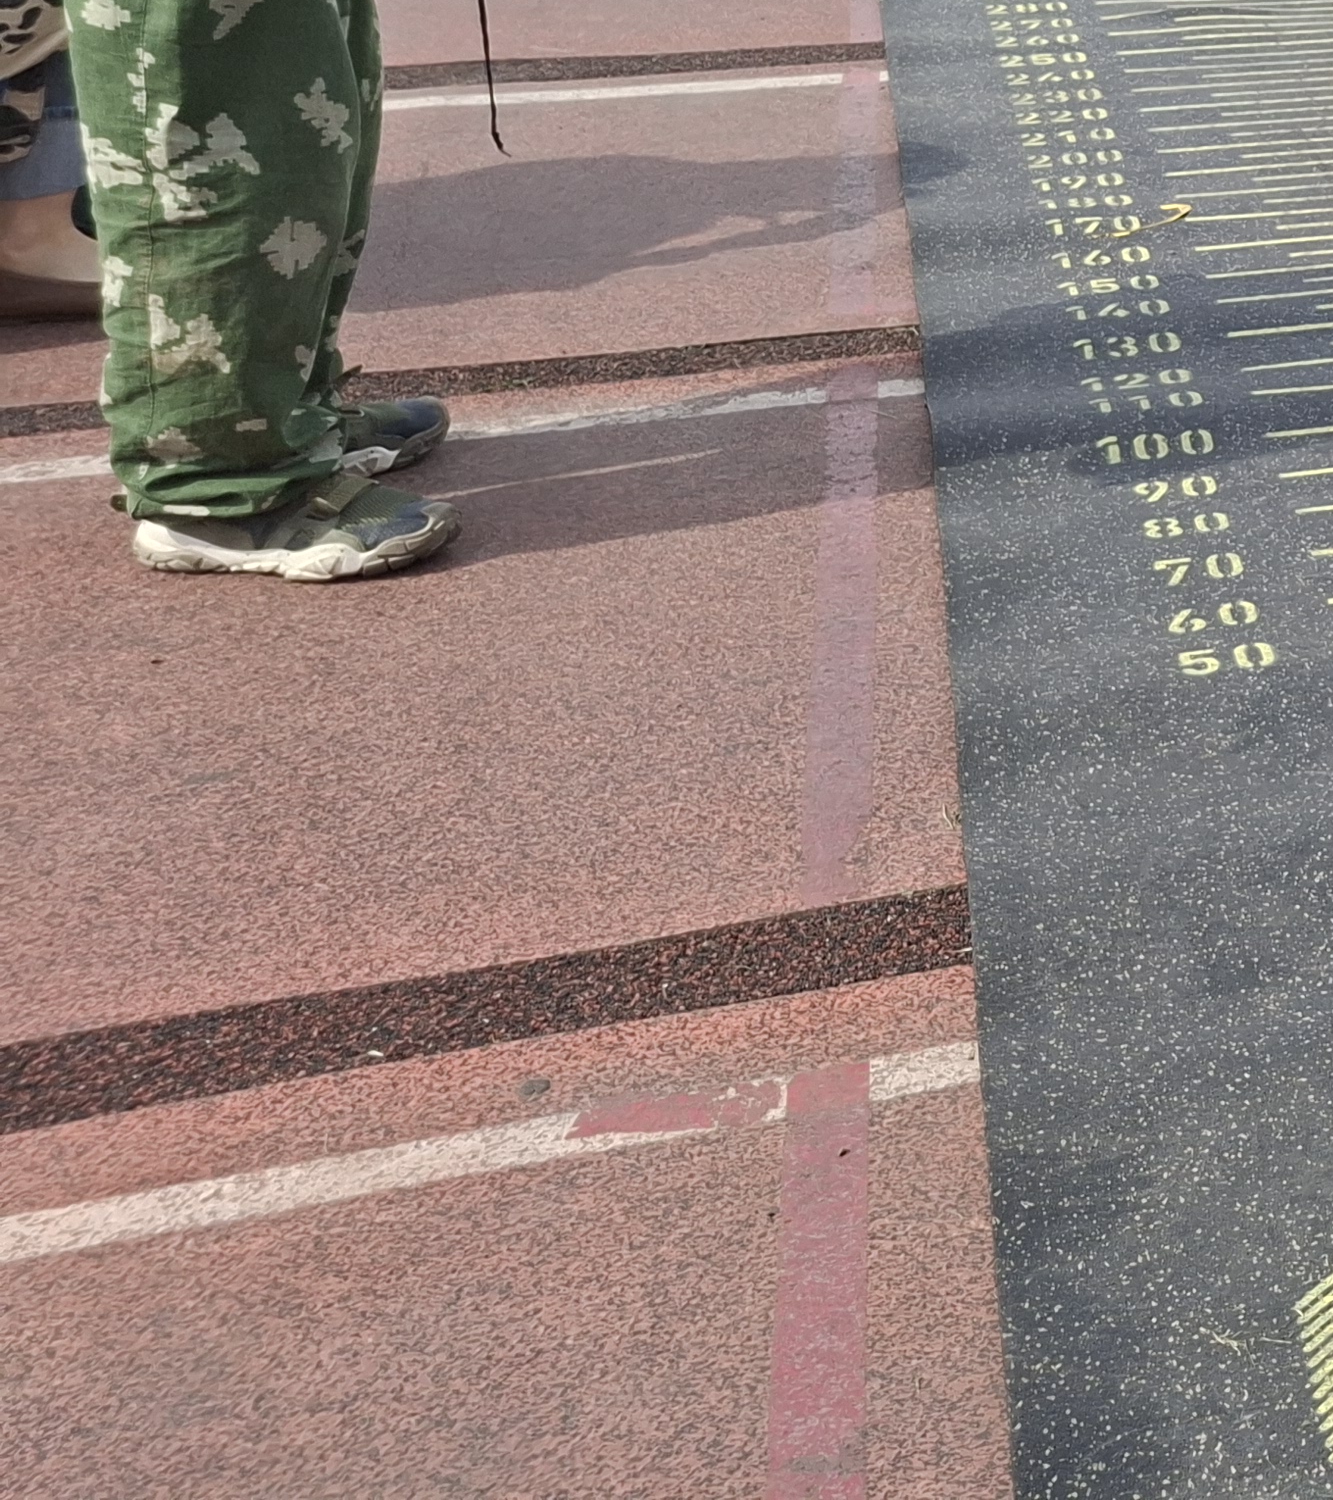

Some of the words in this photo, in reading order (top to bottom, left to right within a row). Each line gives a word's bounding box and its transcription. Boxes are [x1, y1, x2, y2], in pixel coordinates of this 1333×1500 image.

[985, 1, 1068, 15] 280
[989, 18, 1074, 31] 270
[994, 33, 1080, 48] 260
[999, 52, 1088, 68] 250
[1006, 69, 1095, 86] 240
[1011, 88, 1103, 106] 230
[1015, 107, 1108, 126] 220
[1020, 127, 1116, 147] 210
[1026, 150, 1123, 169] 200
[1032, 173, 1125, 192] 190
[1038, 194, 1133, 209] 180
[1045, 215, 1141, 236] 170
[1051, 245, 1150, 269] 160
[1056, 274, 1160, 296] 150
[1065, 299, 1170, 321] 140
[1072, 332, 1182, 360] 130
[1080, 368, 1193, 392] 120
[1088, 390, 1203, 414] 110
[1096, 428, 1215, 465] 100
[1132, 475, 1218, 503] 90
[1143, 512, 1230, 538] 80
[1153, 552, 1244, 587] 70
[1168, 600, 1260, 634] 60
[1177, 642, 1277, 676] 50
